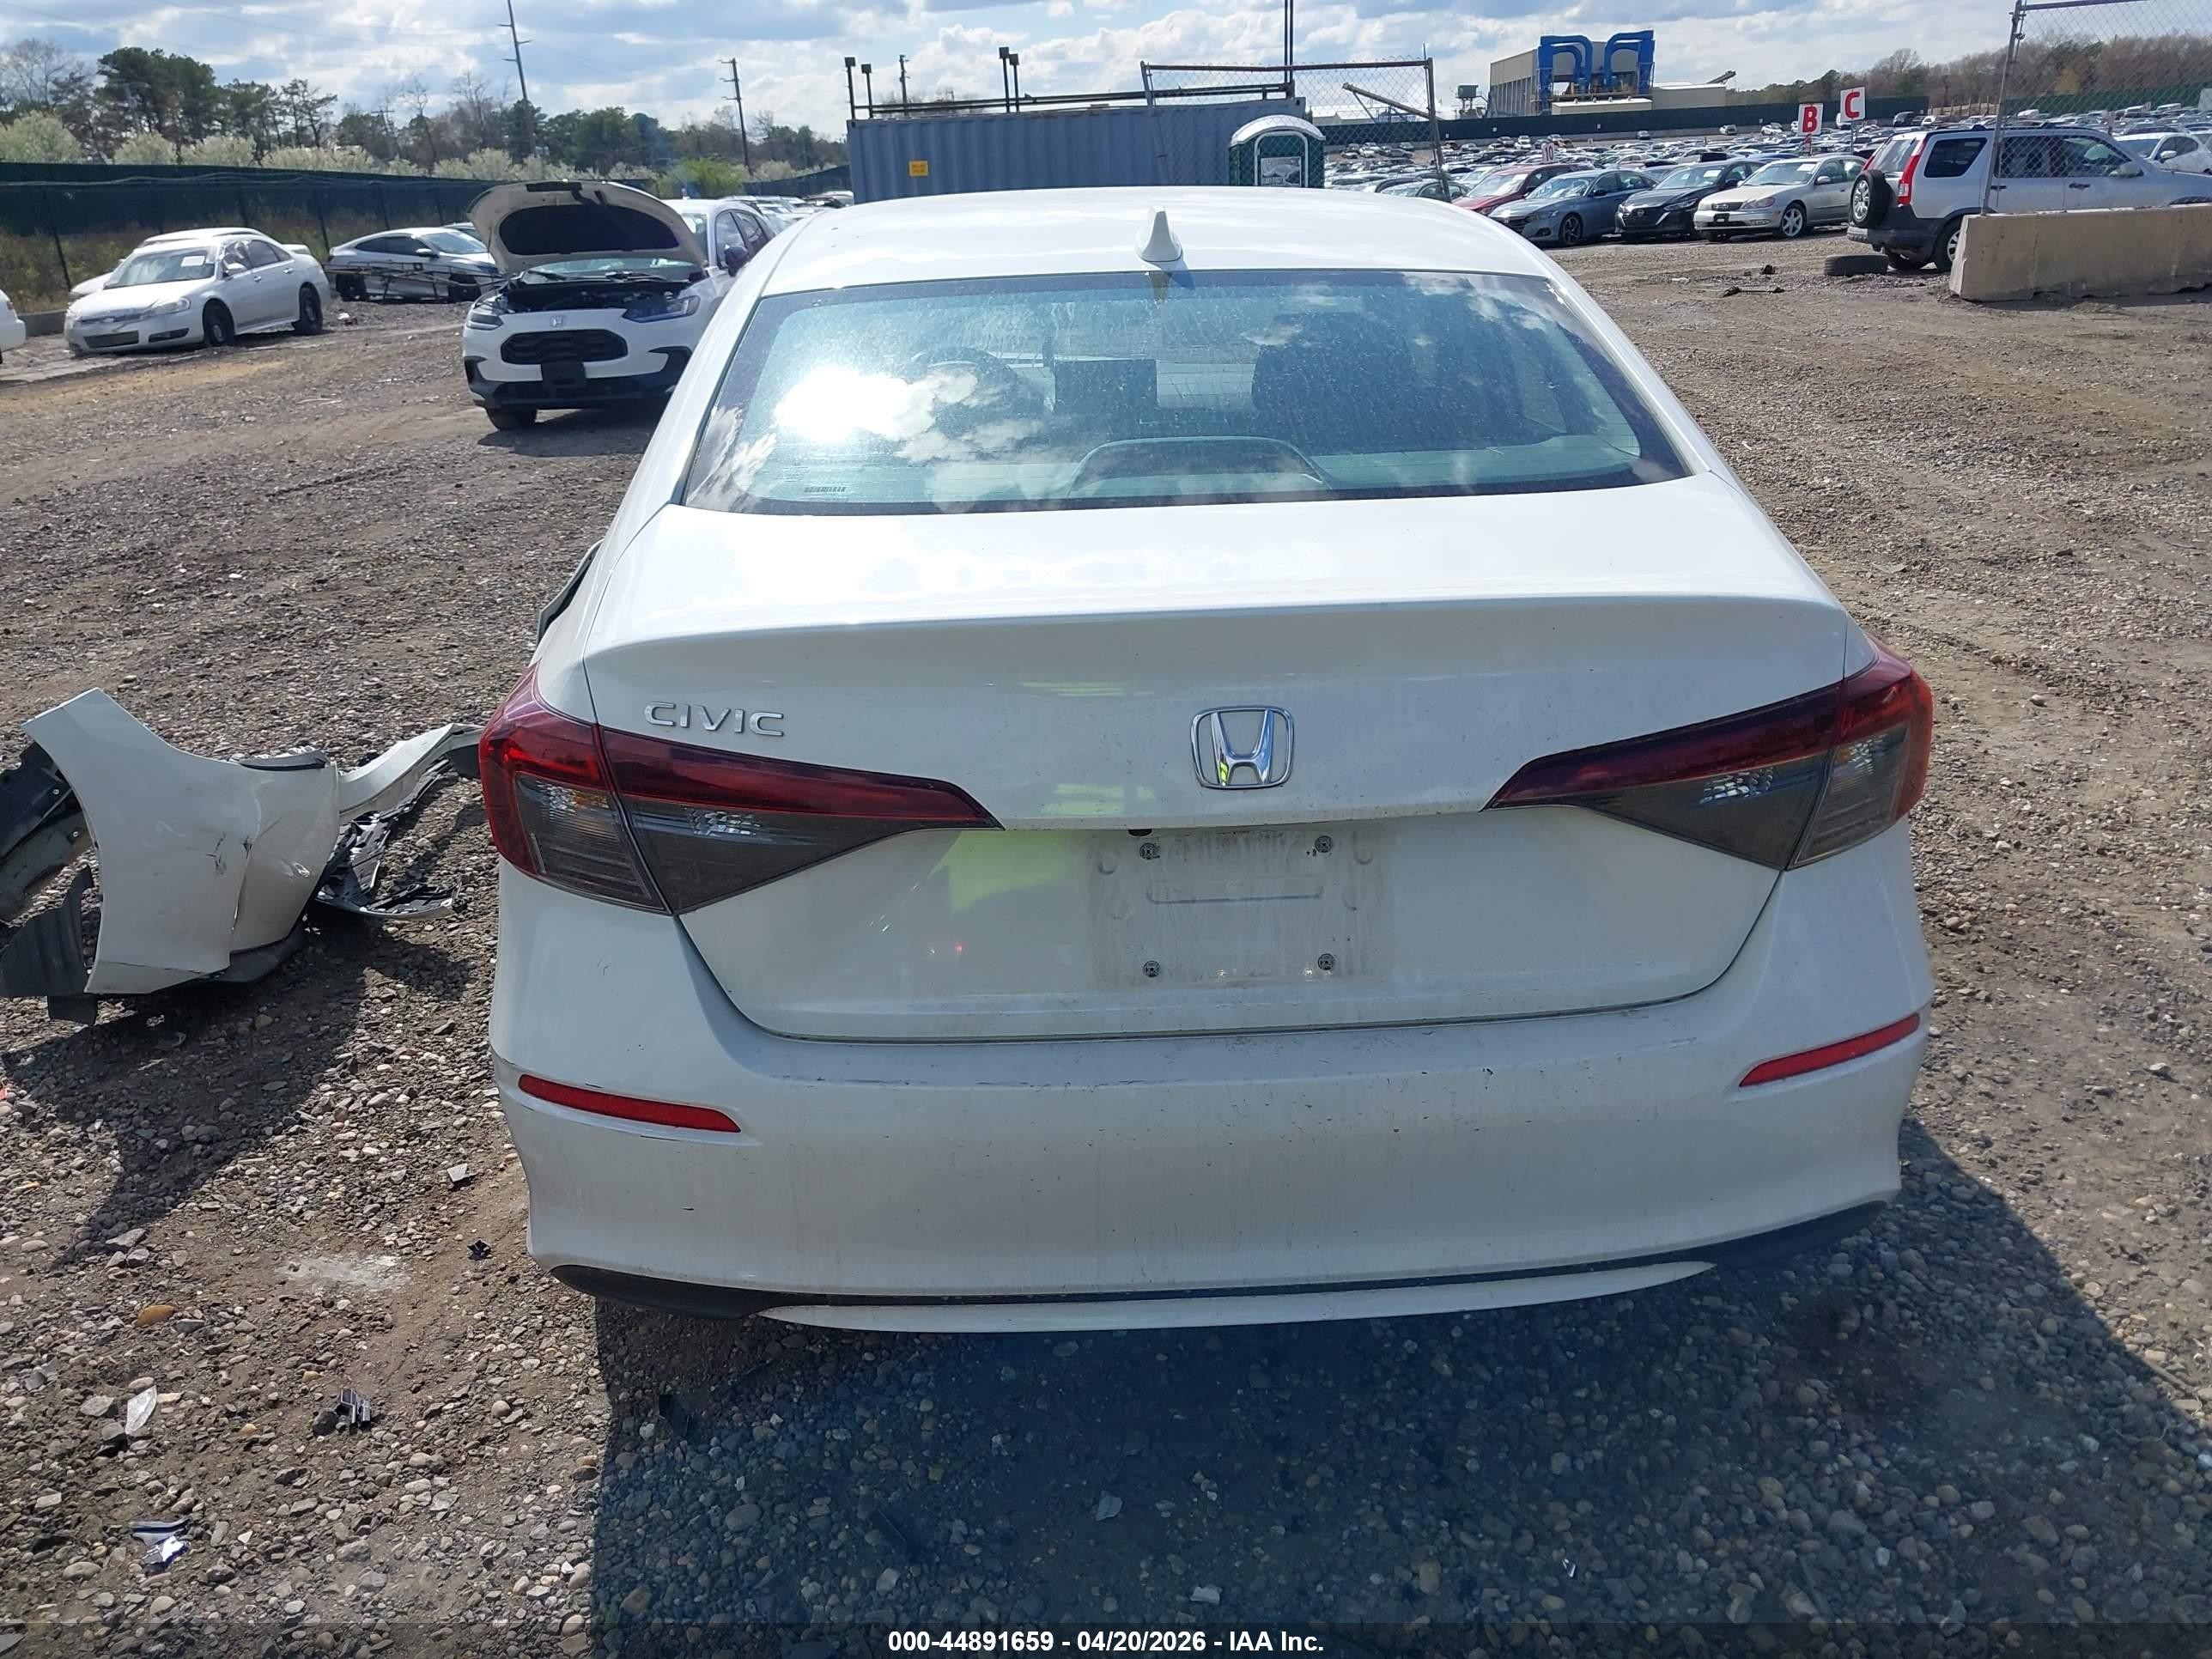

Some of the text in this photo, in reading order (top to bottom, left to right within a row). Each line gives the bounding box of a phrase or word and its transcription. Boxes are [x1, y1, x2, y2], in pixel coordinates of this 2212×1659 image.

[1844, 91, 1861, 118] C
[1802, 106, 1818, 132] B
[644, 701, 784, 737] CIVIC
